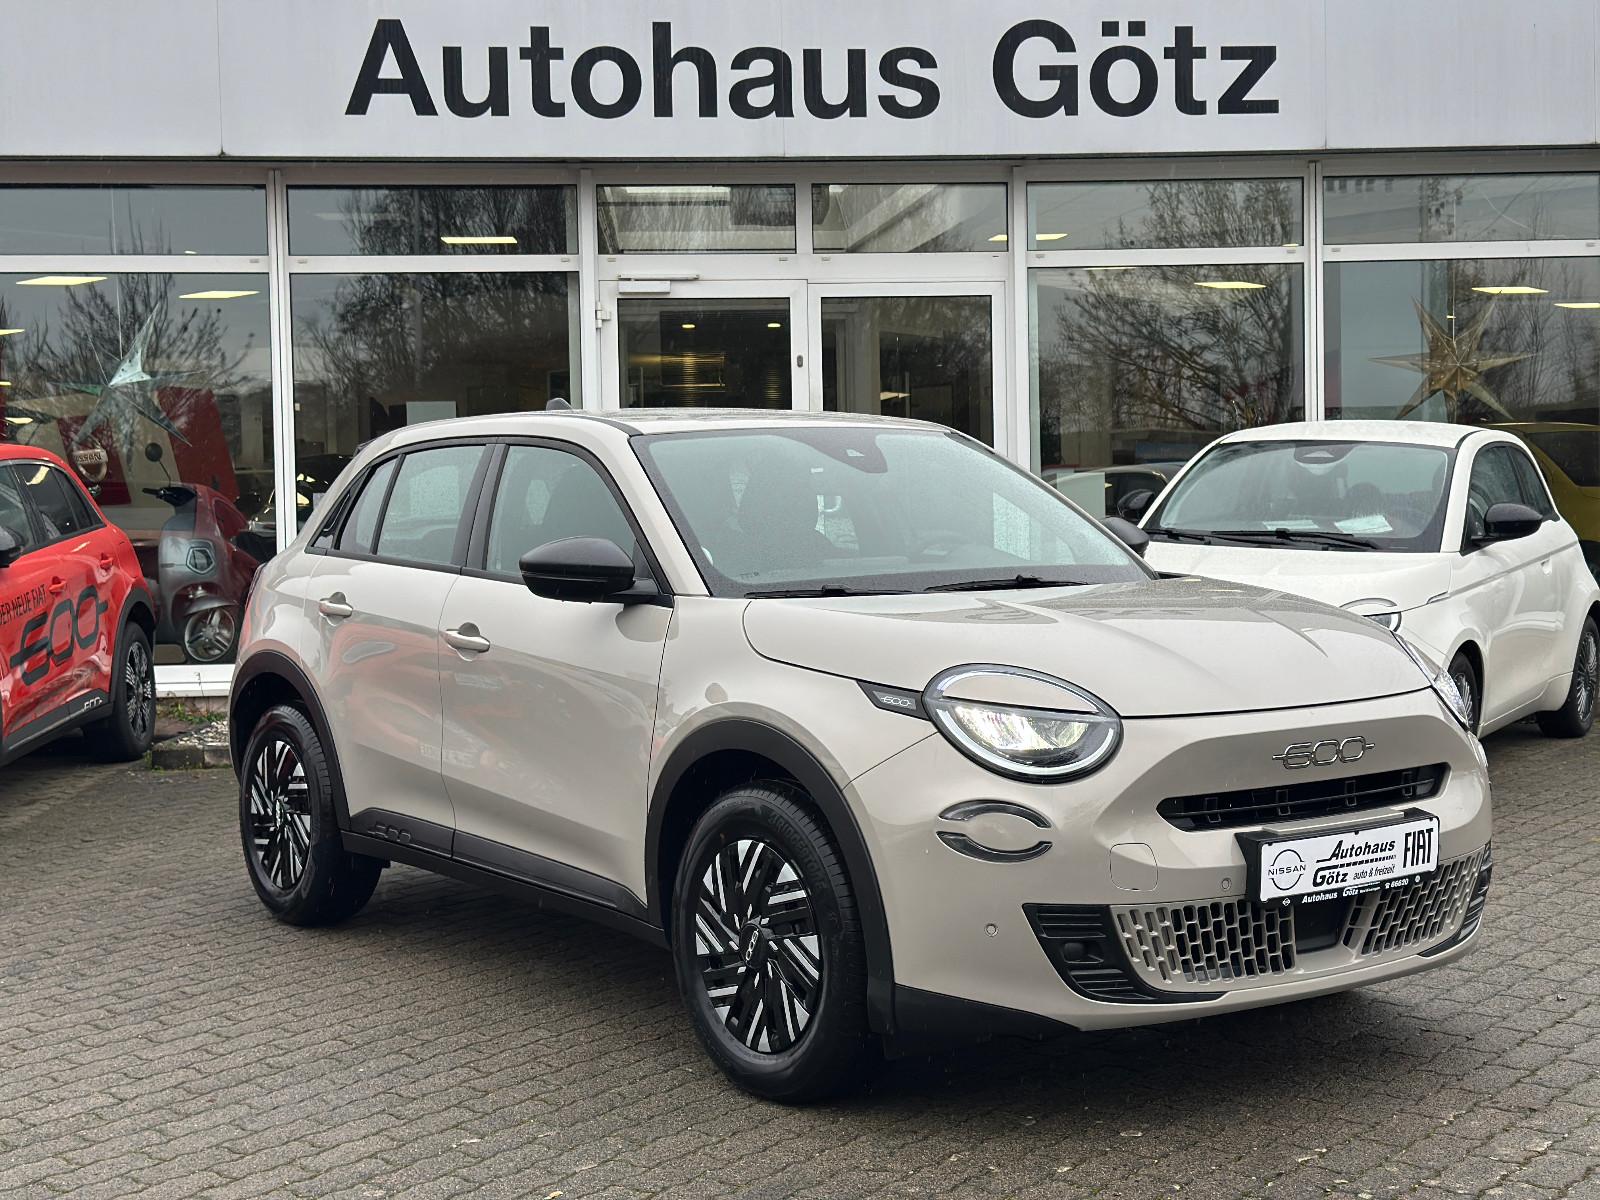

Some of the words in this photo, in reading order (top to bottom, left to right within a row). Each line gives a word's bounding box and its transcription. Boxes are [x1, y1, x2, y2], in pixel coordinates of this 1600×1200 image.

[345, 19, 940, 119] Autohaus
[992, 19, 1280, 119] Götz
[11, 592, 32, 619] NEUE
[31, 584, 46, 608] FIAT
[881, 696, 911, 706] 600
[1272, 735, 1375, 769] 600
[1316, 840, 1396, 863] Autohaus
[1403, 828, 1434, 868] FIAT
[1268, 865, 1307, 876] NISSAN
[1313, 867, 1349, 887] Götz
[1353, 870, 1367, 880] auto
[1368, 868, 1376, 877] &
[1374, 863, 1396, 877] freizeit
[1302, 892, 1338, 904] Autohaus
[1342, 888, 1359, 897] Götz
